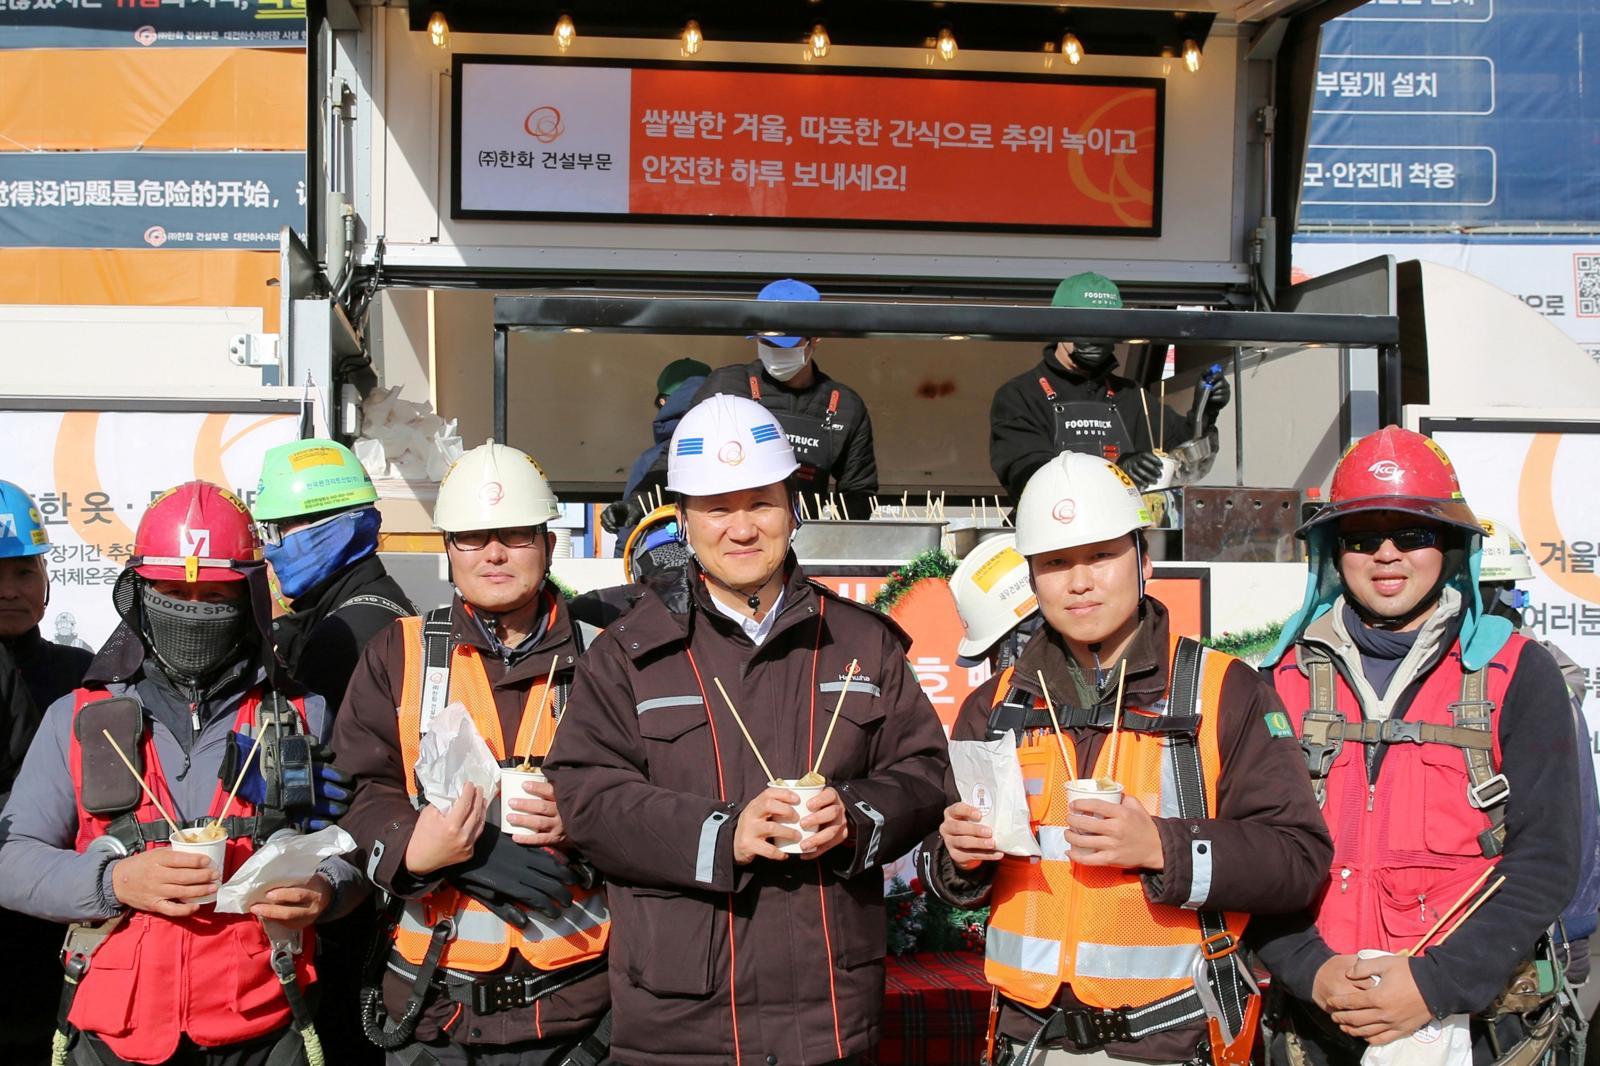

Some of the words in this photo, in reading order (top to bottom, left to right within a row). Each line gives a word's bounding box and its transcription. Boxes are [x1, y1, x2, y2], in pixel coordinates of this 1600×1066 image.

[1316, 71, 1385, 98] 부덮개
[1391, 72, 1438, 98] 설치
[641, 109, 727, 141] 쌀쌀한
[733, 111, 793, 146] 겨울,
[800, 116, 883, 148] 따뜻한
[889, 119, 994, 149] 간식으로
[1001, 124, 1054, 154] 추위
[1060, 128, 1138, 156] 녹이고
[541, 151, 613, 171] 건설부문
[641, 155, 724, 187] 안전한
[730, 158, 786, 188] 하루
[791, 161, 908, 193] 보내세요!
[1408, 162, 1456, 189] 착용
[233, 232, 281, 242] 대전하수처리
[1065, 420, 1112, 429] FOODTRUCK
[31, 491, 72, 526] 한
[80, 491, 114, 525] 옷
[50, 543, 103, 563] 장기간
[1539, 540, 1600, 574] 겨울
[50, 567, 118, 587] 저체온증
